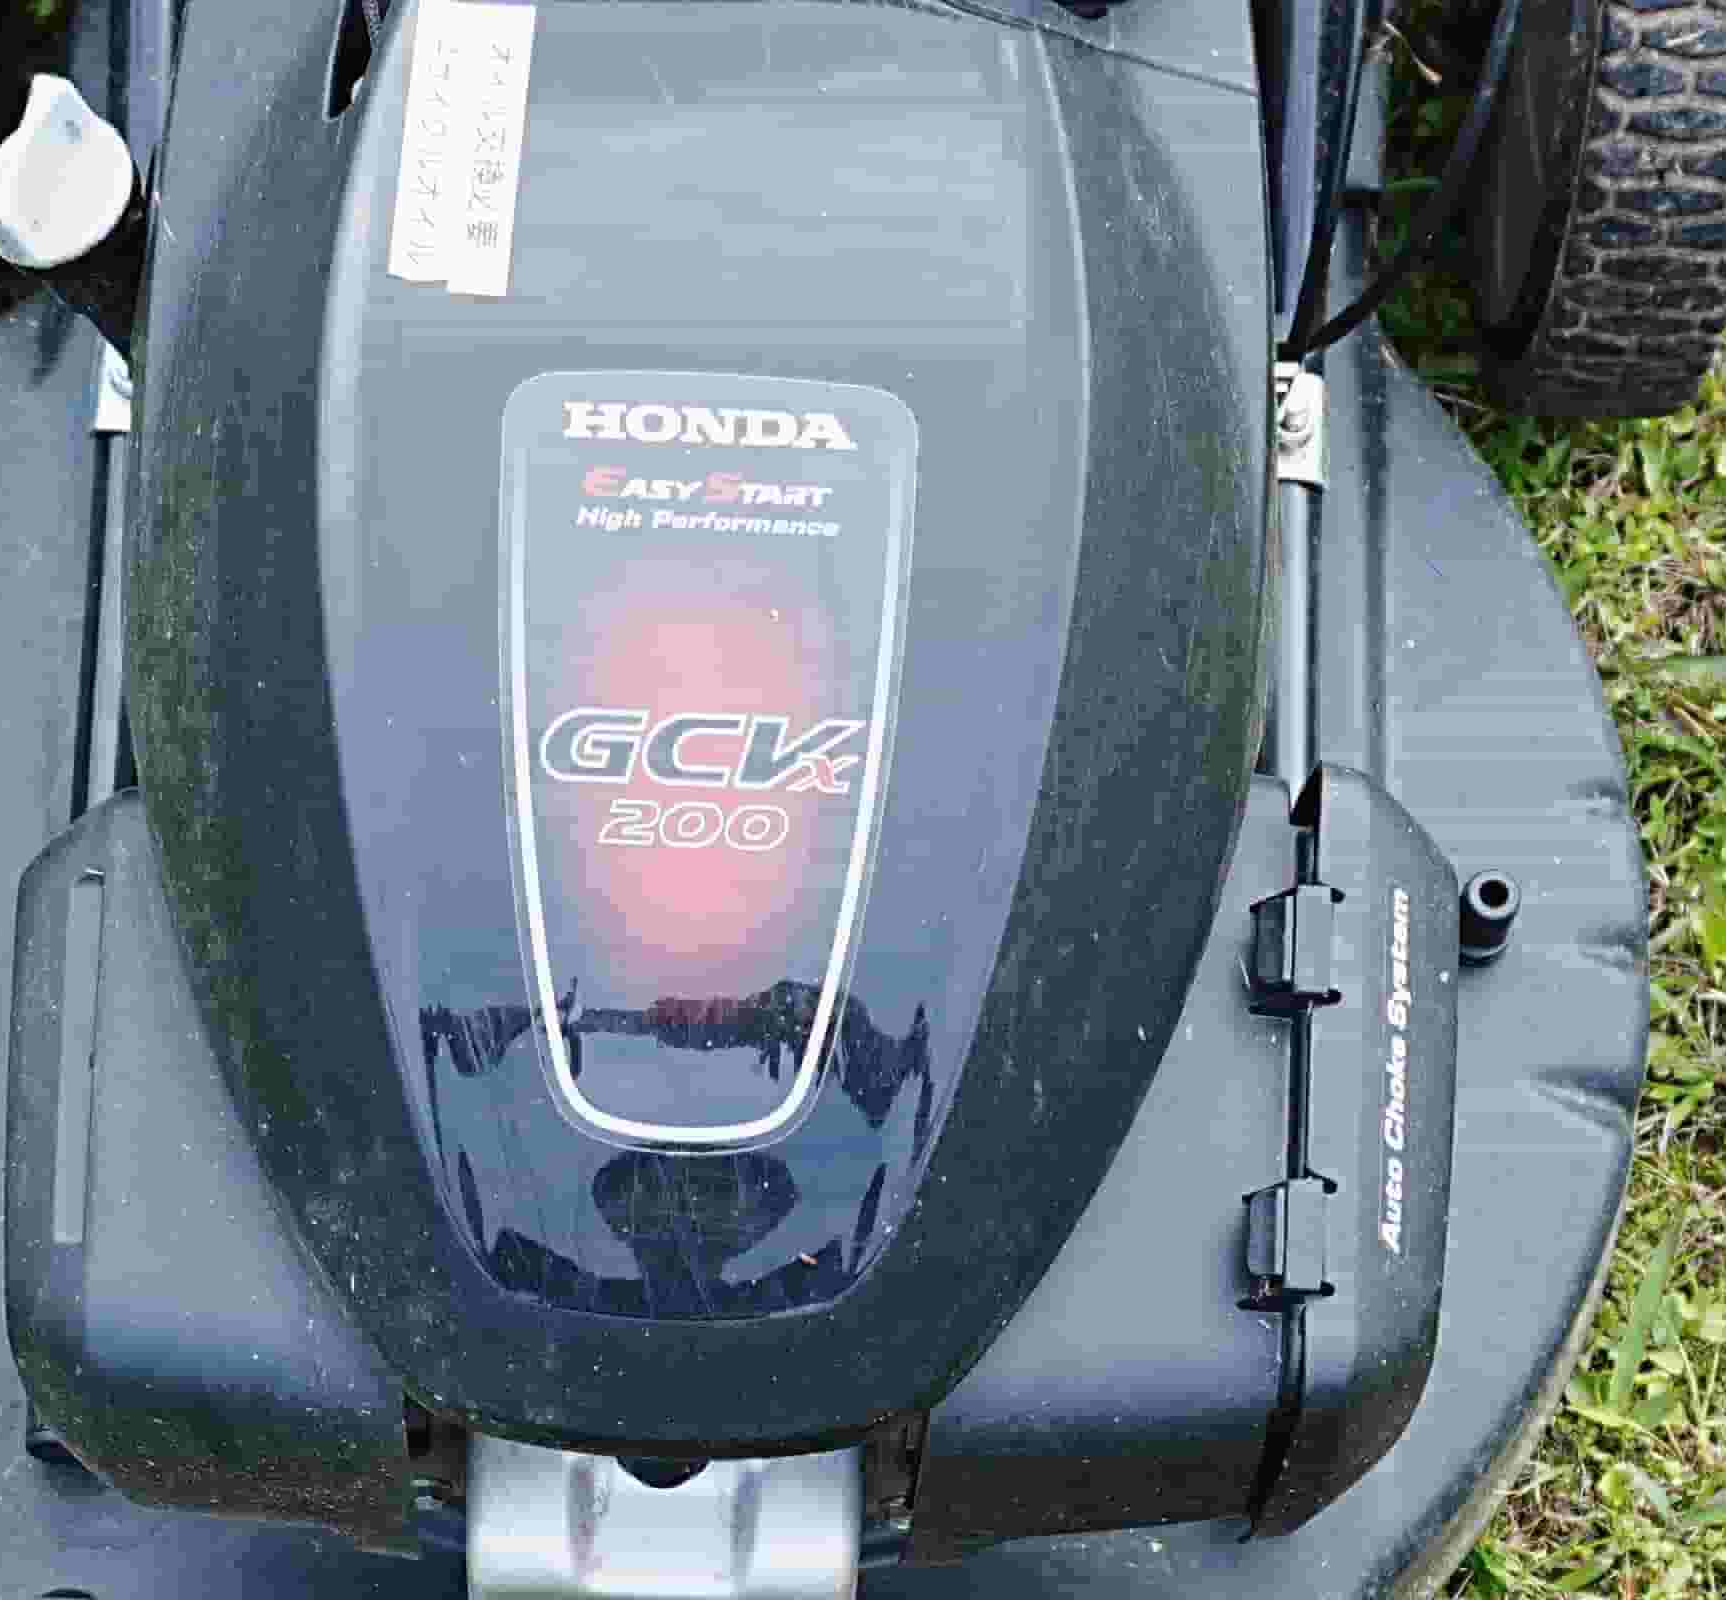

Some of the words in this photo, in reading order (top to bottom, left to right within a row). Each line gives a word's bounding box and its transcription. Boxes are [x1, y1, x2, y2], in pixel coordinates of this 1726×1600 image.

[562, 400, 858, 451] HONDA
[574, 505, 644, 534] High
[650, 508, 842, 538] Performance
[595, 799, 790, 850] 200
[1388, 886, 1413, 1028] System
[1384, 1036, 1408, 1151] Choke
[1378, 1157, 1406, 1255] Auto
